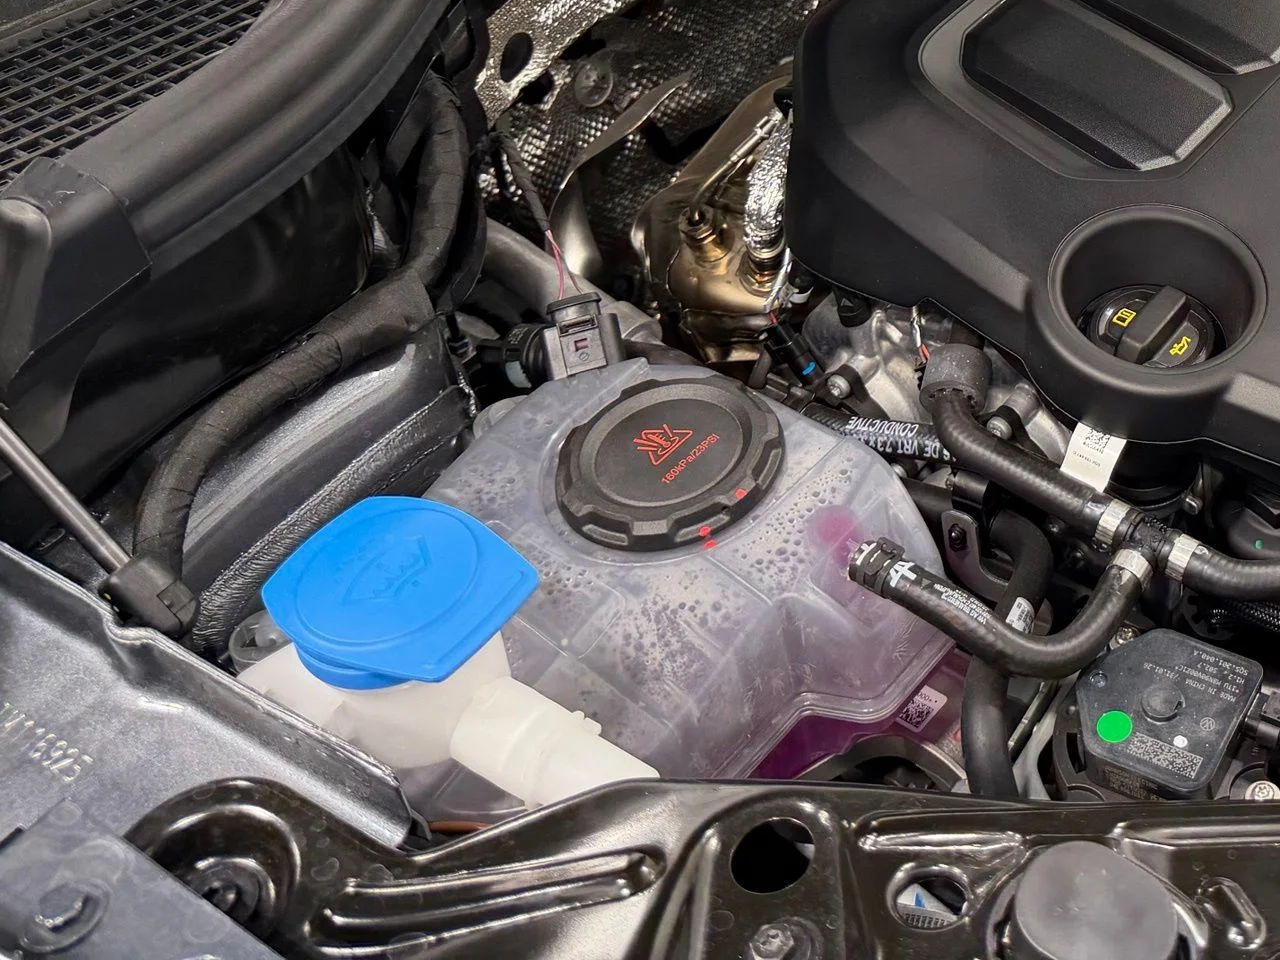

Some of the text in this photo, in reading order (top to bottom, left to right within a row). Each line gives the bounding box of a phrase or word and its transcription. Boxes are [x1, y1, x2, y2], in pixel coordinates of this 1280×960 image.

[846, 415, 918, 437] CONDUCTIVE
[1185, 678, 1205, 689] CHINA
[1219, 691, 1236, 702] MADE
